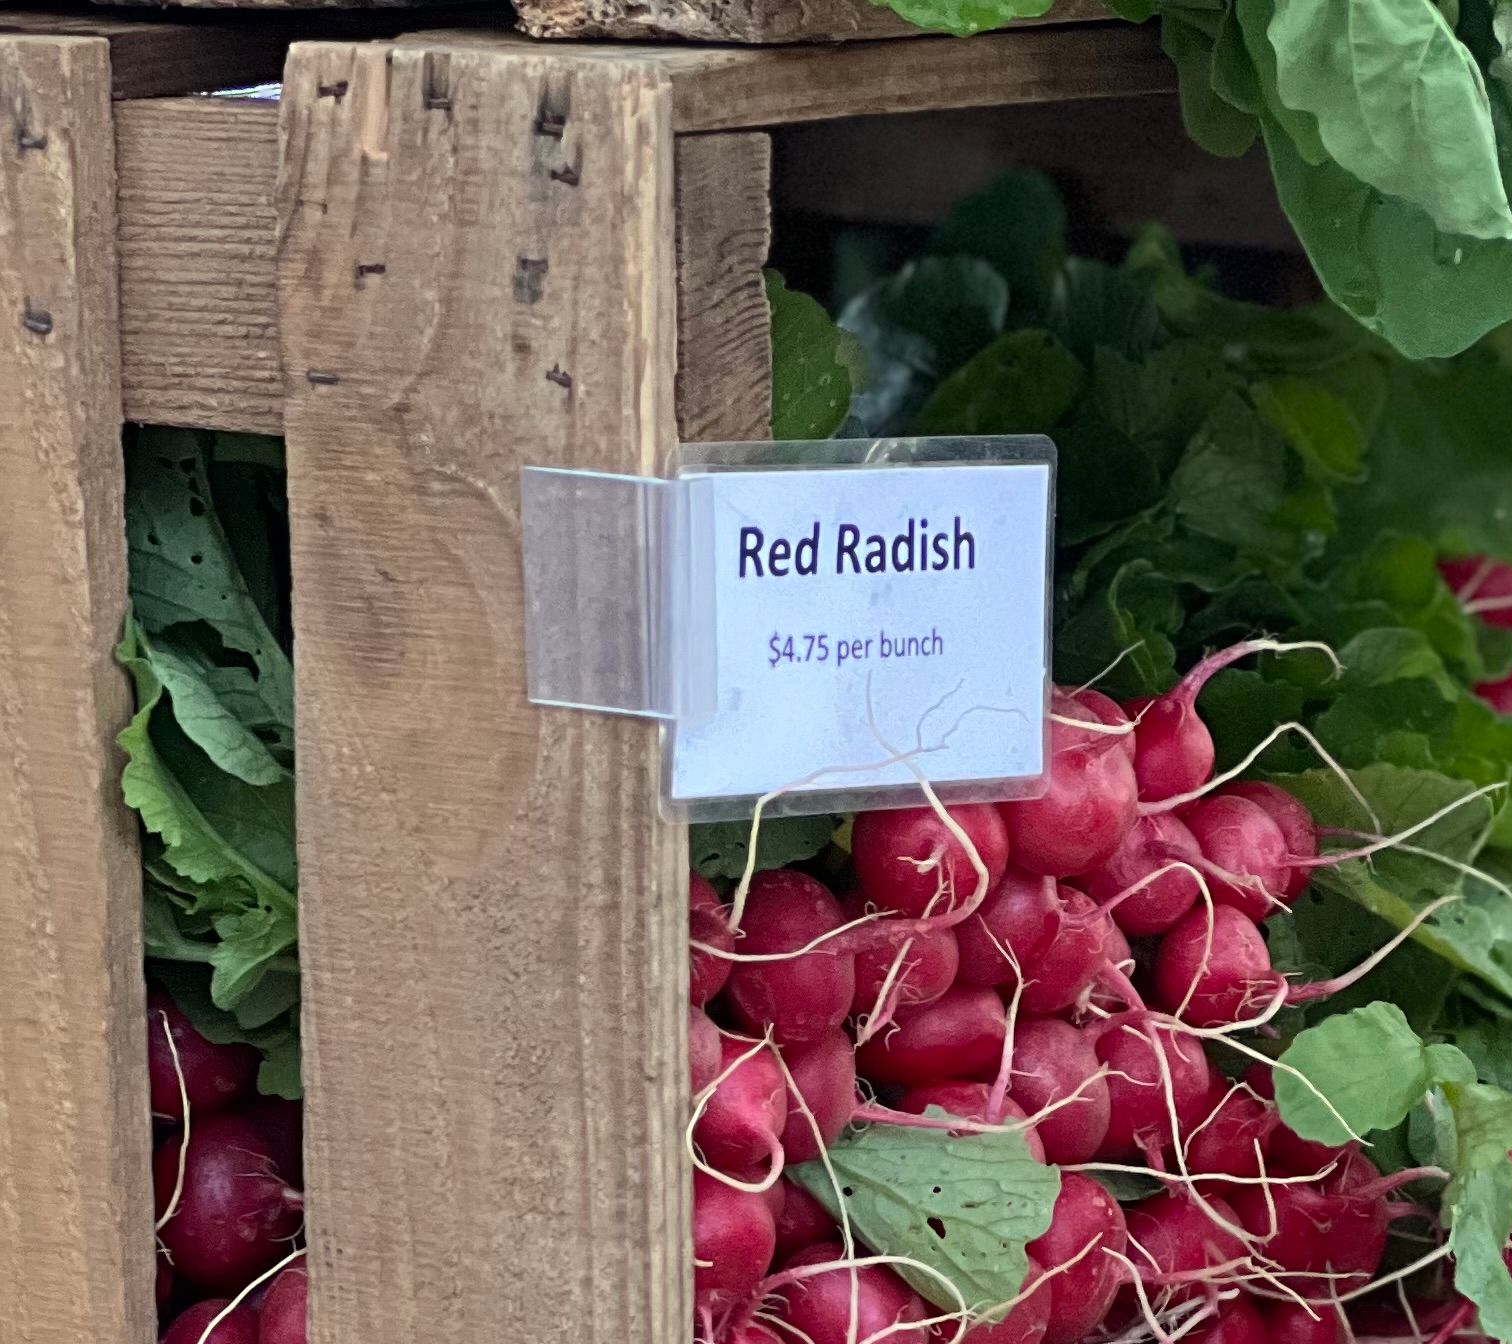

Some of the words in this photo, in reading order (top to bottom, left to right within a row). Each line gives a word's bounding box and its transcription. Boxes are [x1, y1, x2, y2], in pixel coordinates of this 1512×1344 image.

[738, 521, 821, 579] Red
[836, 515, 976, 576] Radish
[768, 630, 830, 669] $4.75
[836, 639, 874, 668] per
[879, 627, 944, 659] bunch
